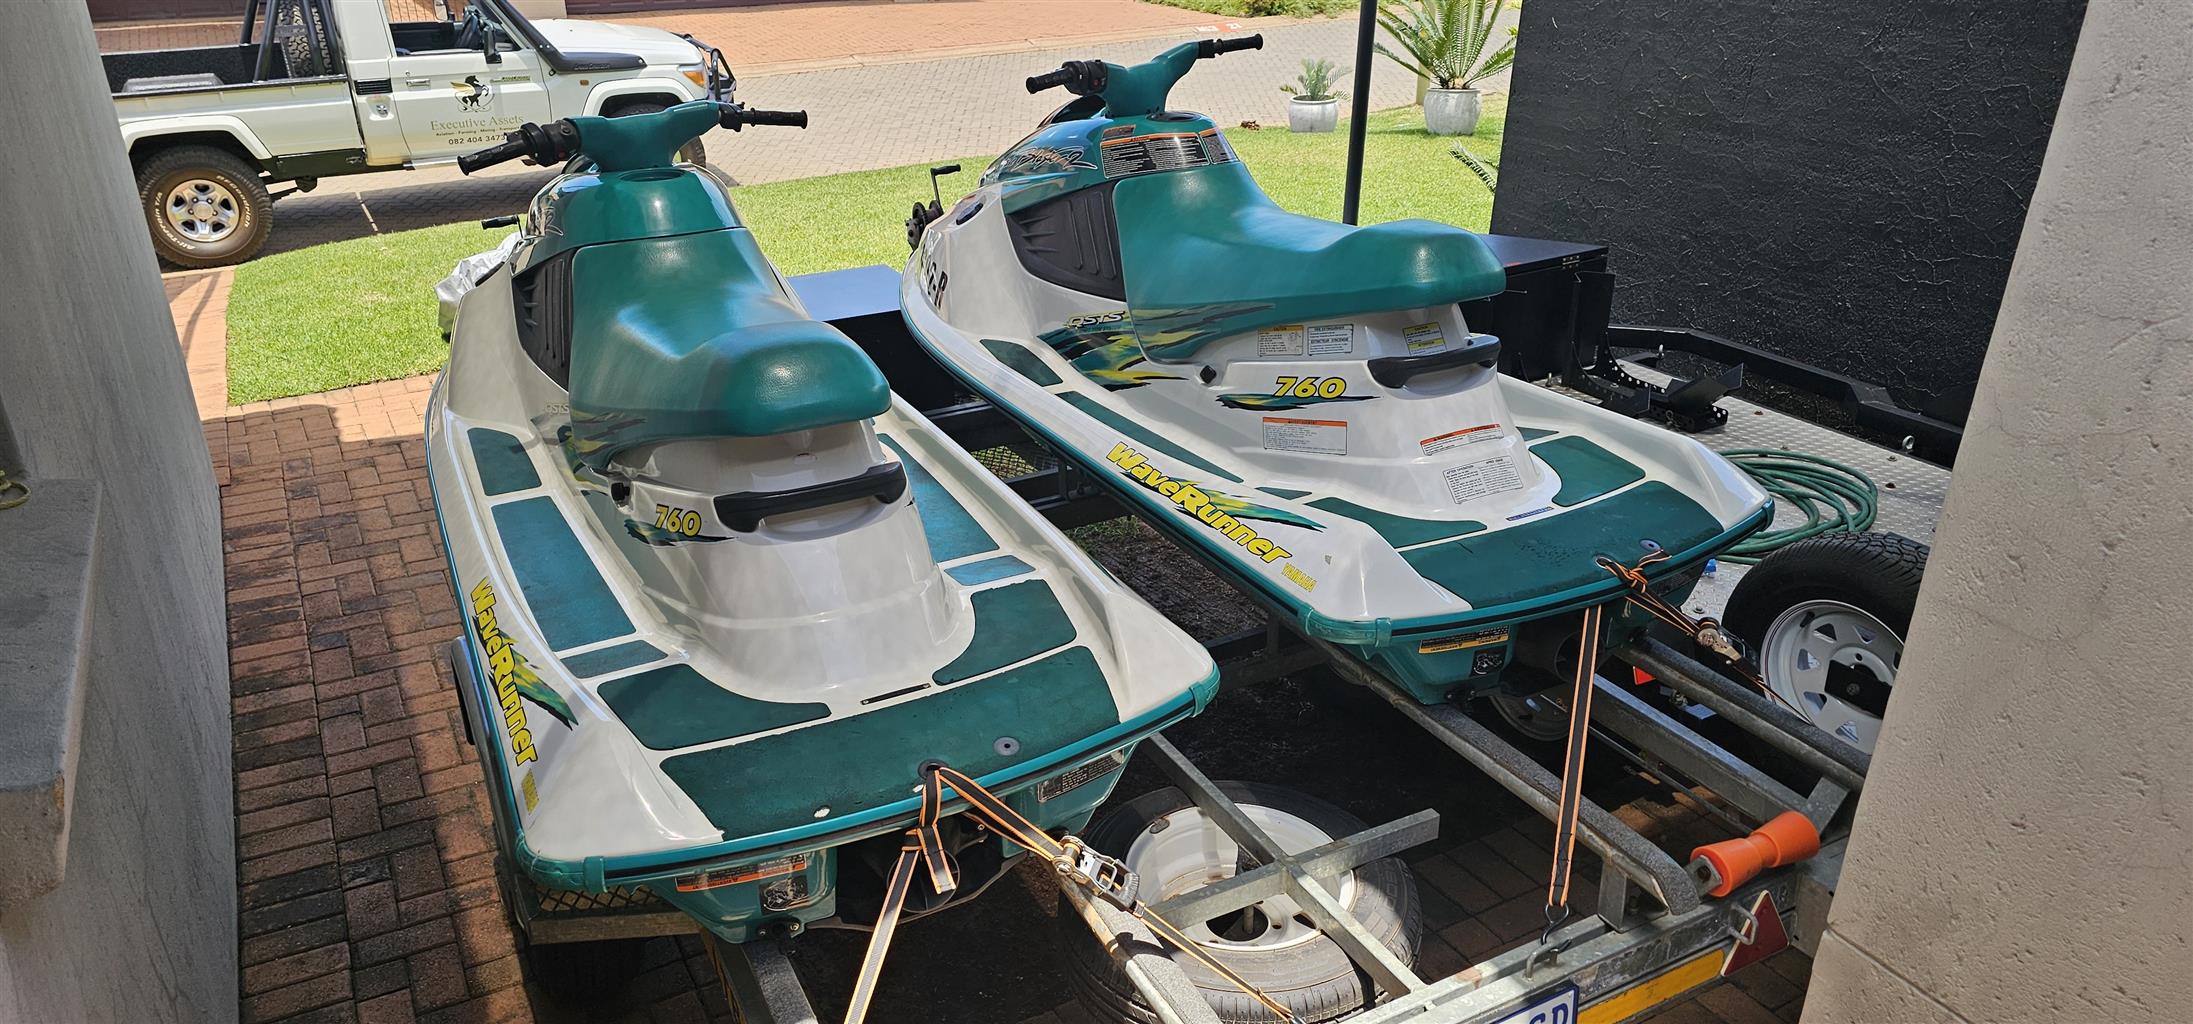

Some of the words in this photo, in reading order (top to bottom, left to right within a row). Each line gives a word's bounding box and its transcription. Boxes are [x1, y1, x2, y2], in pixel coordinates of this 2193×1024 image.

[430, 118, 486, 130] Executive
[489, 115, 524, 126] Assets
[154, 191, 163, 206] T/A
[1064, 310, 1126, 329] QSTS
[1271, 376, 1347, 399] 760
[1105, 441, 1293, 564] WaveRunner
[655, 503, 702, 538] 760
[470, 576, 538, 767] WaveRunner
